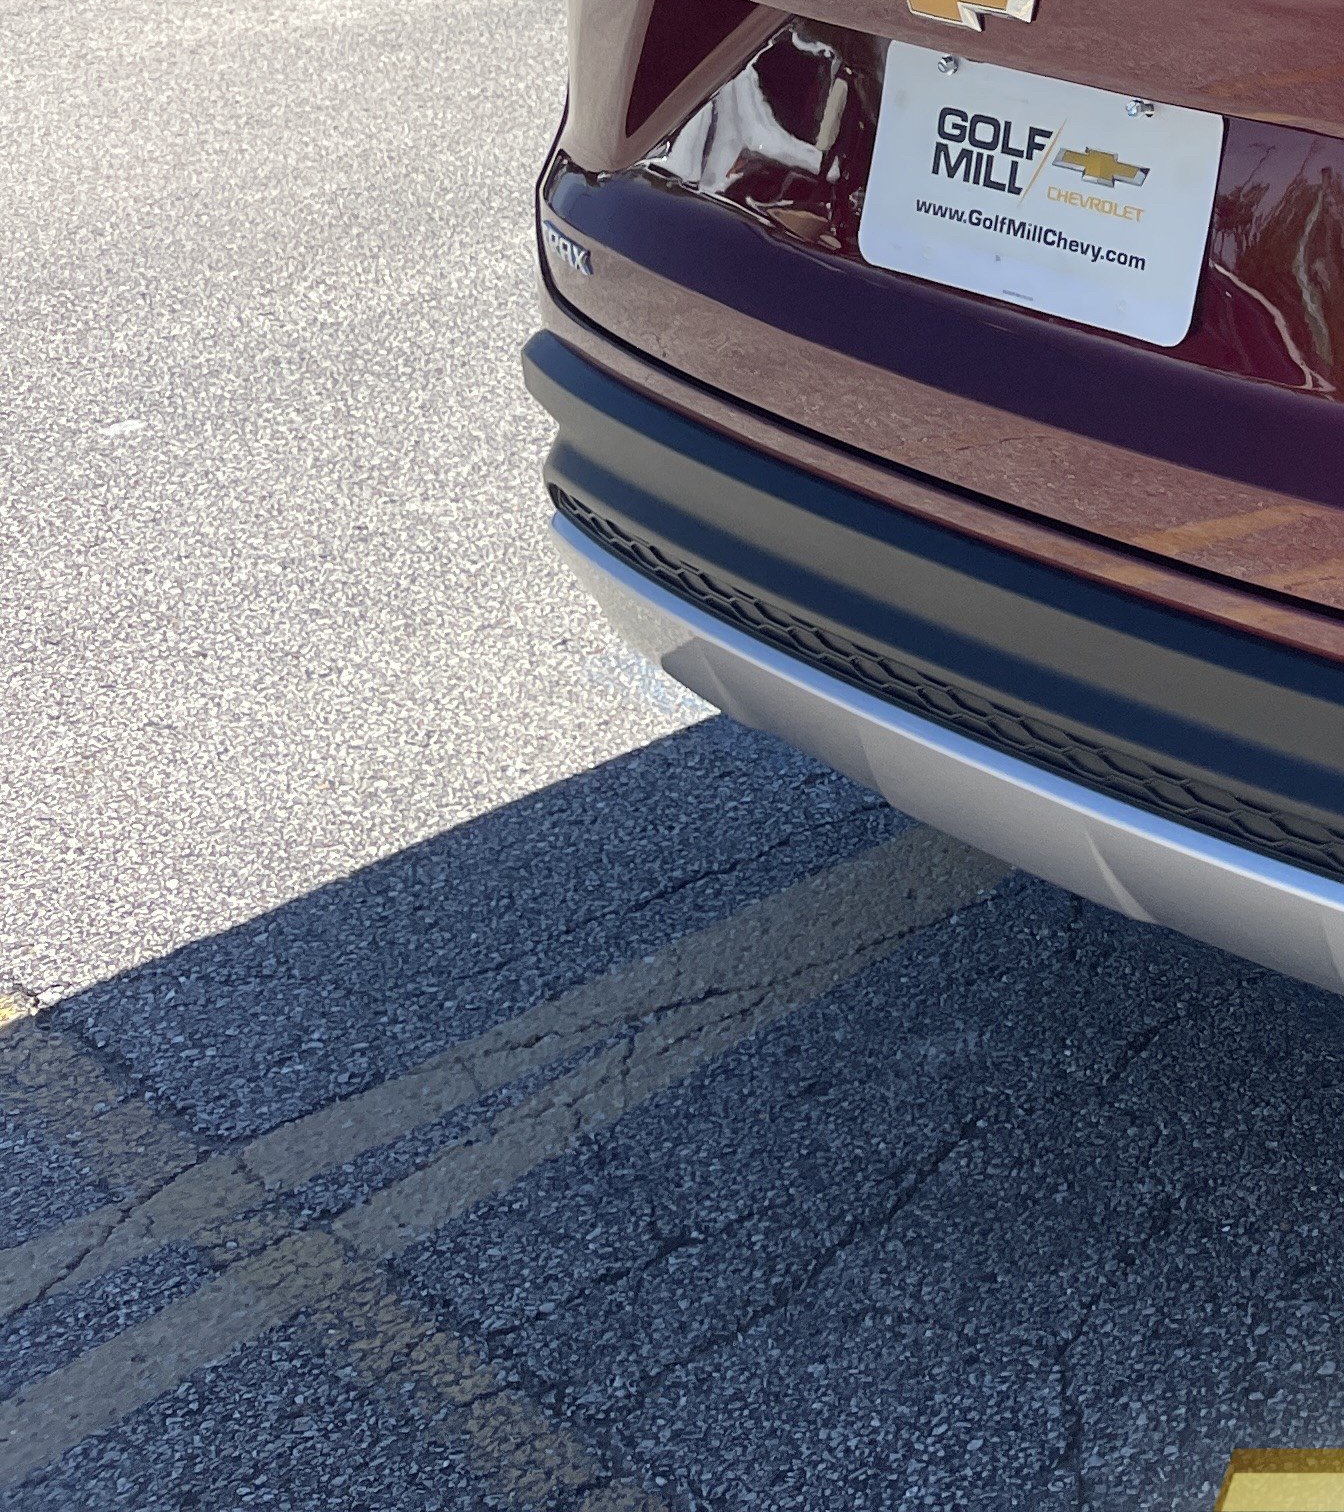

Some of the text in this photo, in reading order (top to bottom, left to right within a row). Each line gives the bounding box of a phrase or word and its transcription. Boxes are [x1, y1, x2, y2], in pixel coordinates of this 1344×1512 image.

[938, 107, 1054, 162] GOLF
[931, 142, 1024, 196] MILL
[1046, 185, 1145, 223] CHEVROLET
[915, 197, 1146, 272] www.GolfMillChevy.com
